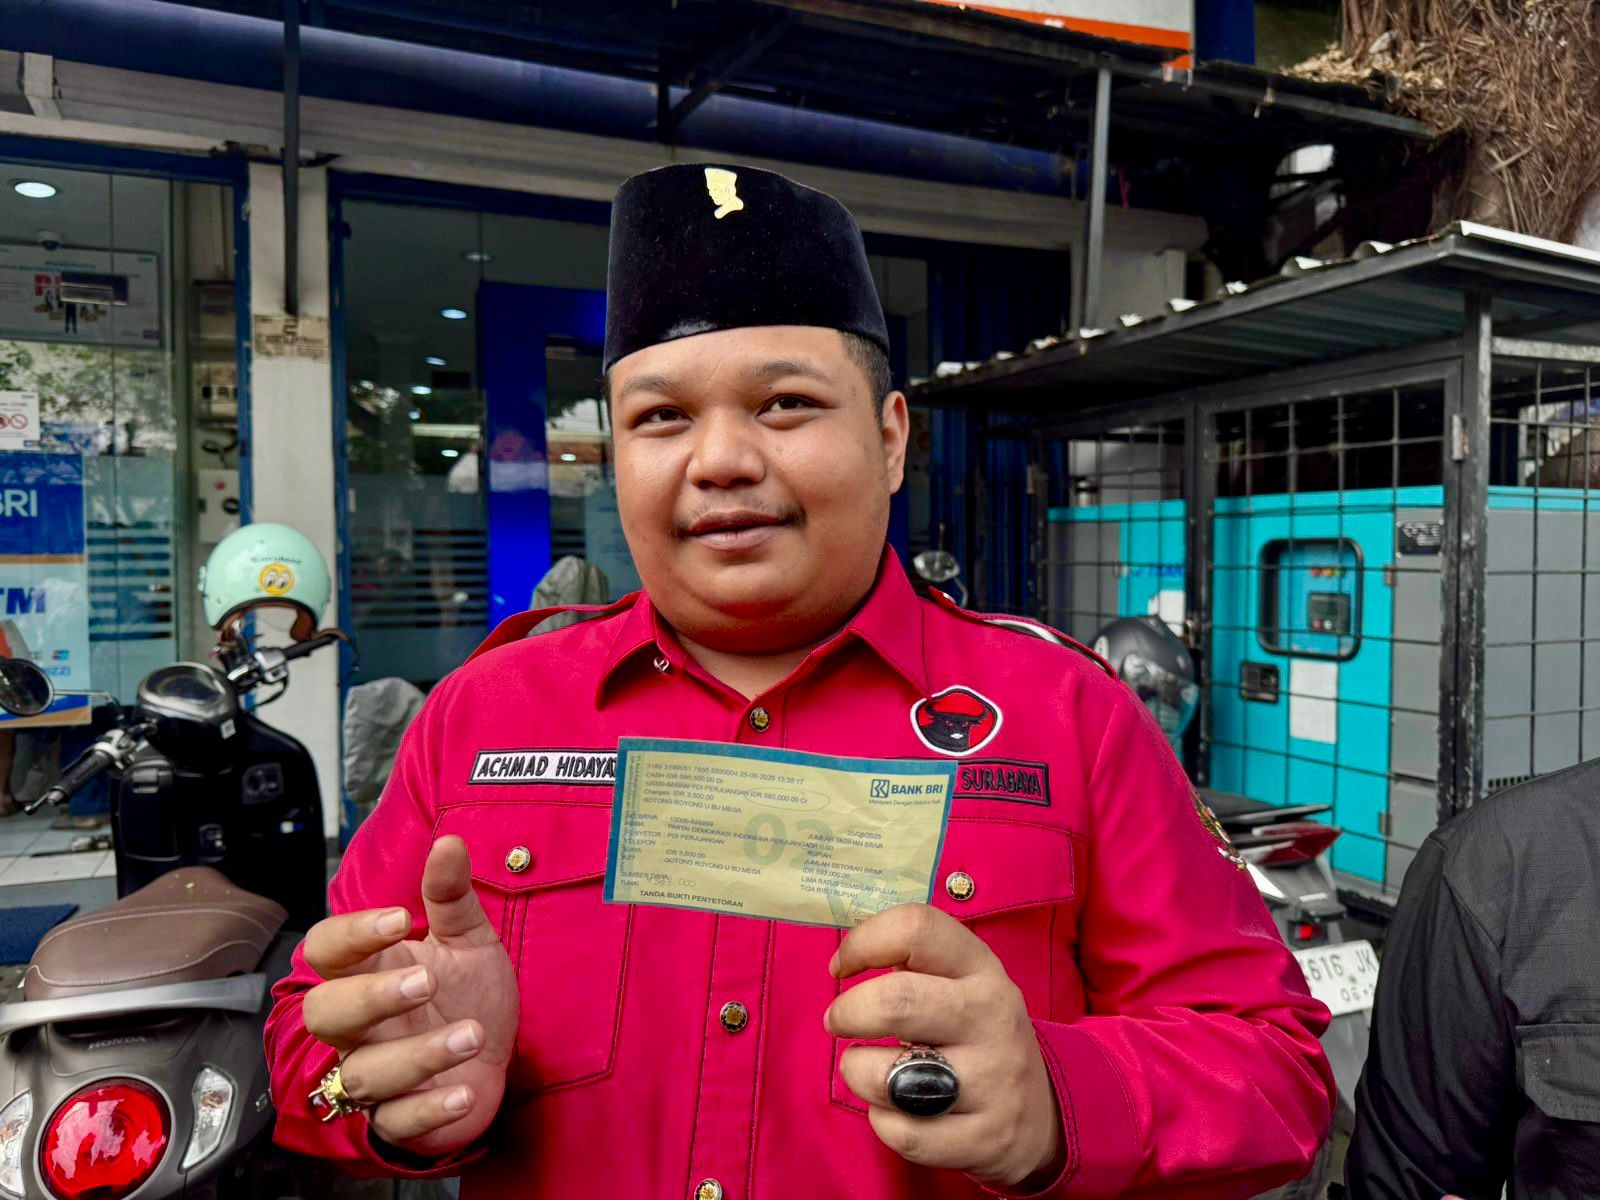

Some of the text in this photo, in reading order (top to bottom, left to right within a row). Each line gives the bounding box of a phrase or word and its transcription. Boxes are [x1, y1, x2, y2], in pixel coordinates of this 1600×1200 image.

[477, 755, 549, 778] ACHMAD
[962, 768, 1042, 796] SURABAYA
[891, 784, 943, 795] BANK BRI
[721, 804, 742, 814] MEGA
[667, 824, 690, 834] PARTAI
[691, 826, 732, 838] DEMOKRASI
[732, 832, 769, 842] INDONESIA
[680, 833, 724, 845] PERJUANGAN
[835, 837, 863, 848] TAGIHAN
[664, 857, 693, 866] GOTONG
[694, 860, 724, 870] ROYONG
[741, 866, 761, 875] MEGA
[831, 862, 863, 872] SETORAN
[801, 876, 817, 885] LIMA
[799, 884, 816, 892] TIGA
[639, 890, 744, 908] TANDA BUKTI PENYETORAN
[1302, 949, 1377, 982] 616 JK
[87, 1036, 148, 1051] HONDA
